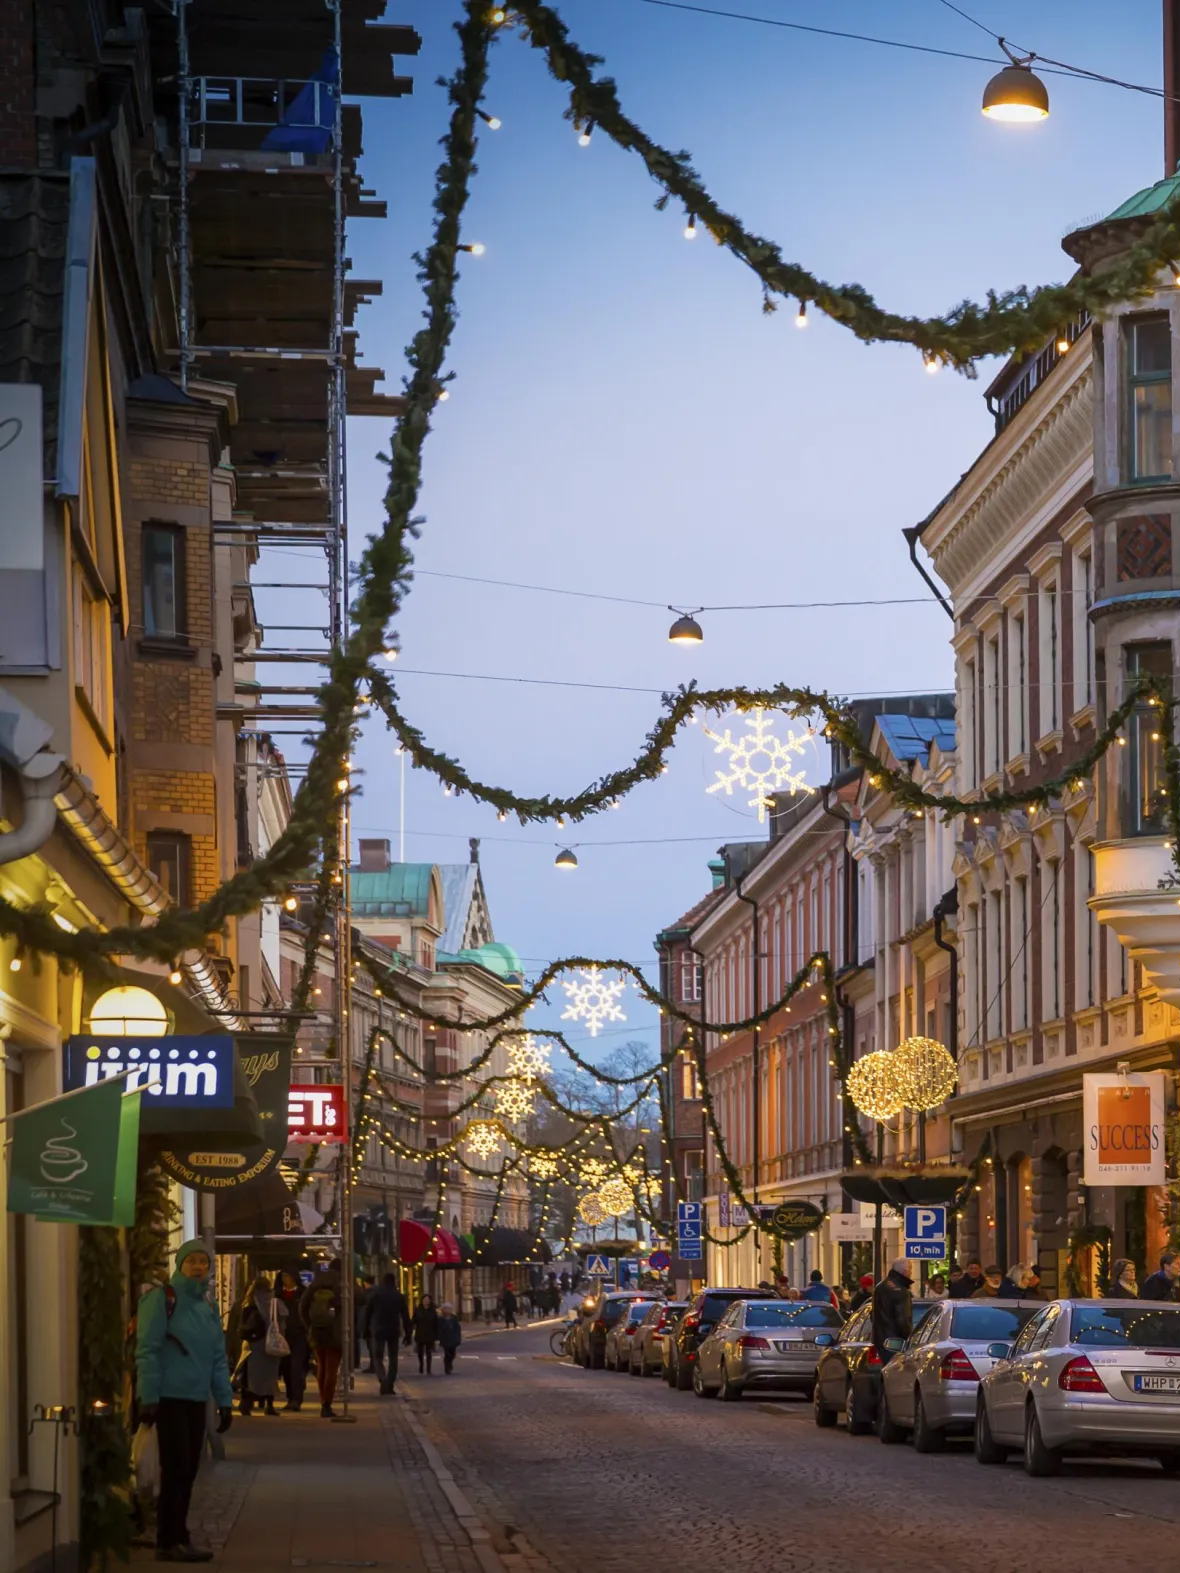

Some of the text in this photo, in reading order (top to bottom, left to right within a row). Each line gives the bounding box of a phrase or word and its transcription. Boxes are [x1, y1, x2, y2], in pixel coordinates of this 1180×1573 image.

[1090, 1124, 1159, 1151] SUCCESS
[195, 1155, 240, 1165] EST 1988
[203, 1176, 237, 1188] EATING
[237, 1148, 277, 1184] EMPORIUM
[684, 1203, 696, 1219] P
[916, 1209, 937, 1237] P
[923, 1246, 941, 1255] min
[1143, 1378, 1168, 1389] WHP
